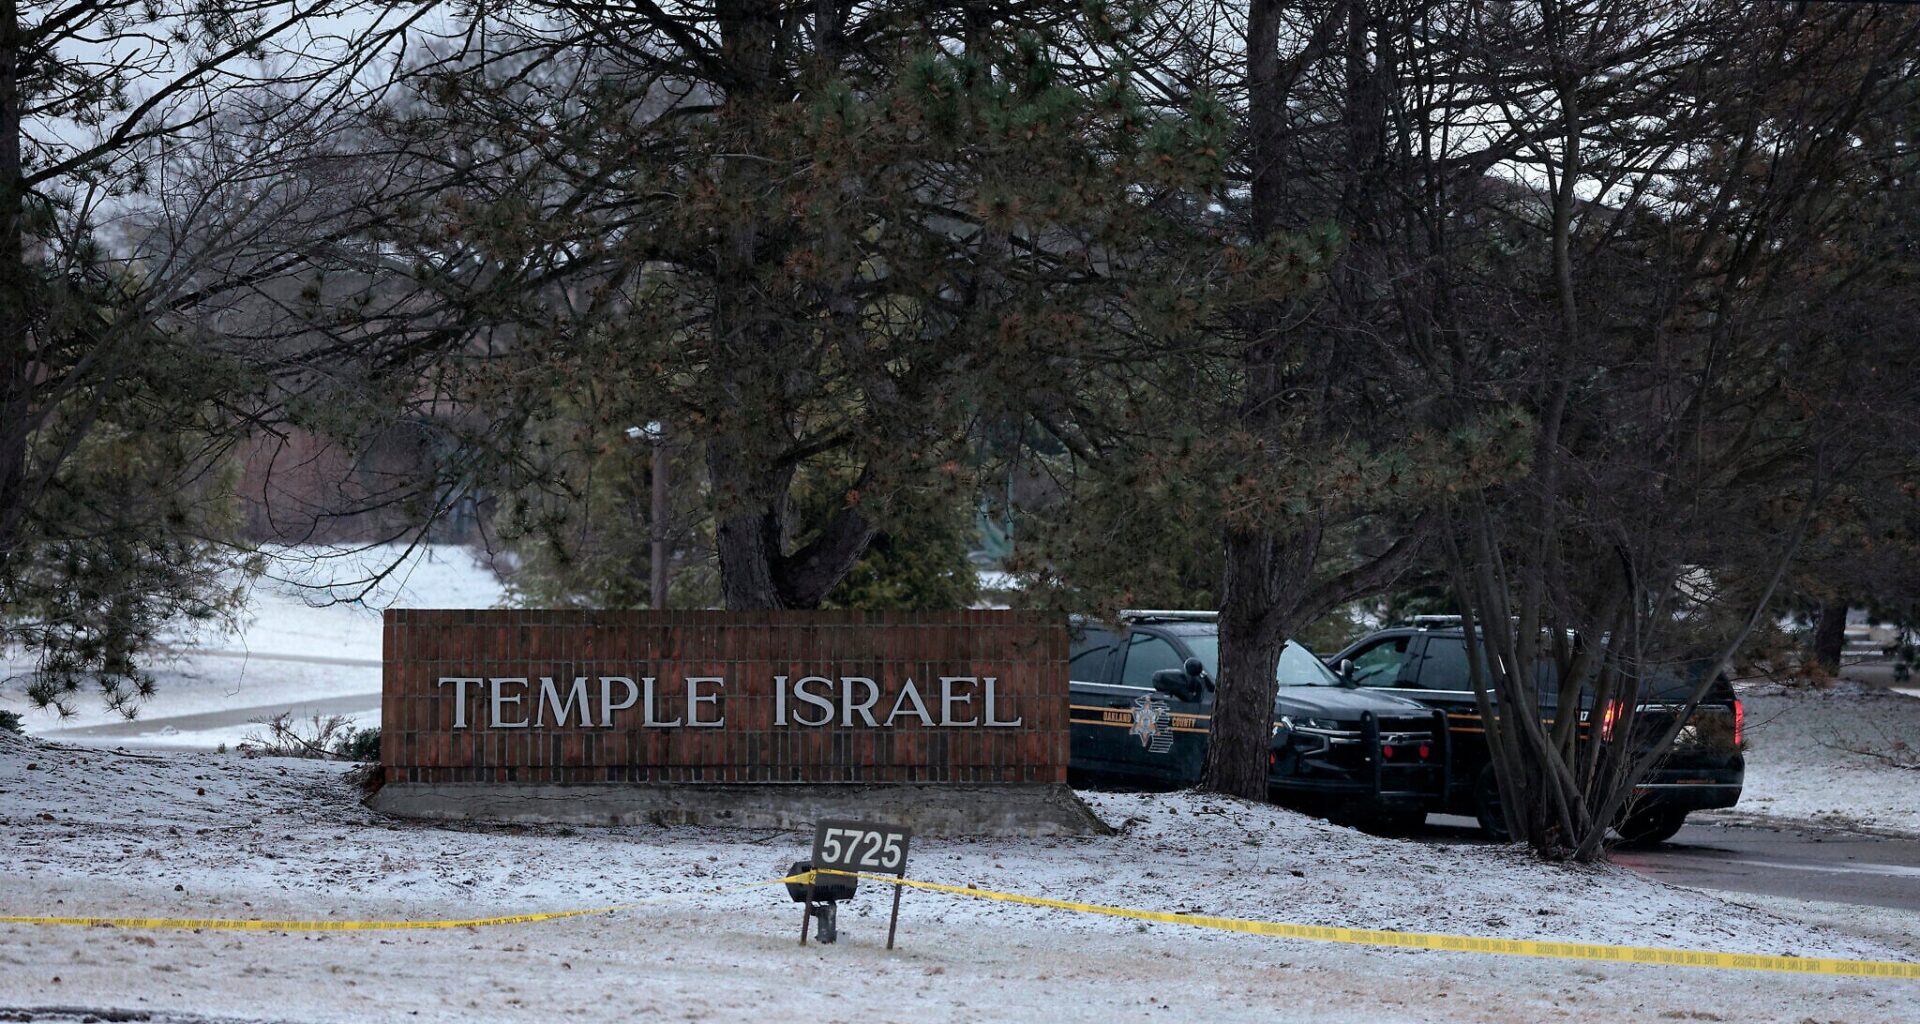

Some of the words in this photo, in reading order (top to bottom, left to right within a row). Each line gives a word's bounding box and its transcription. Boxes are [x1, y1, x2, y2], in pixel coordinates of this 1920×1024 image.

[438, 676, 725, 728] TEMPLE
[774, 675, 1022, 728] ISRAEL
[1103, 711, 1131, 722] OAKLAND
[1172, 717, 1196, 728] COUNTY
[822, 828, 903, 868] 5725
